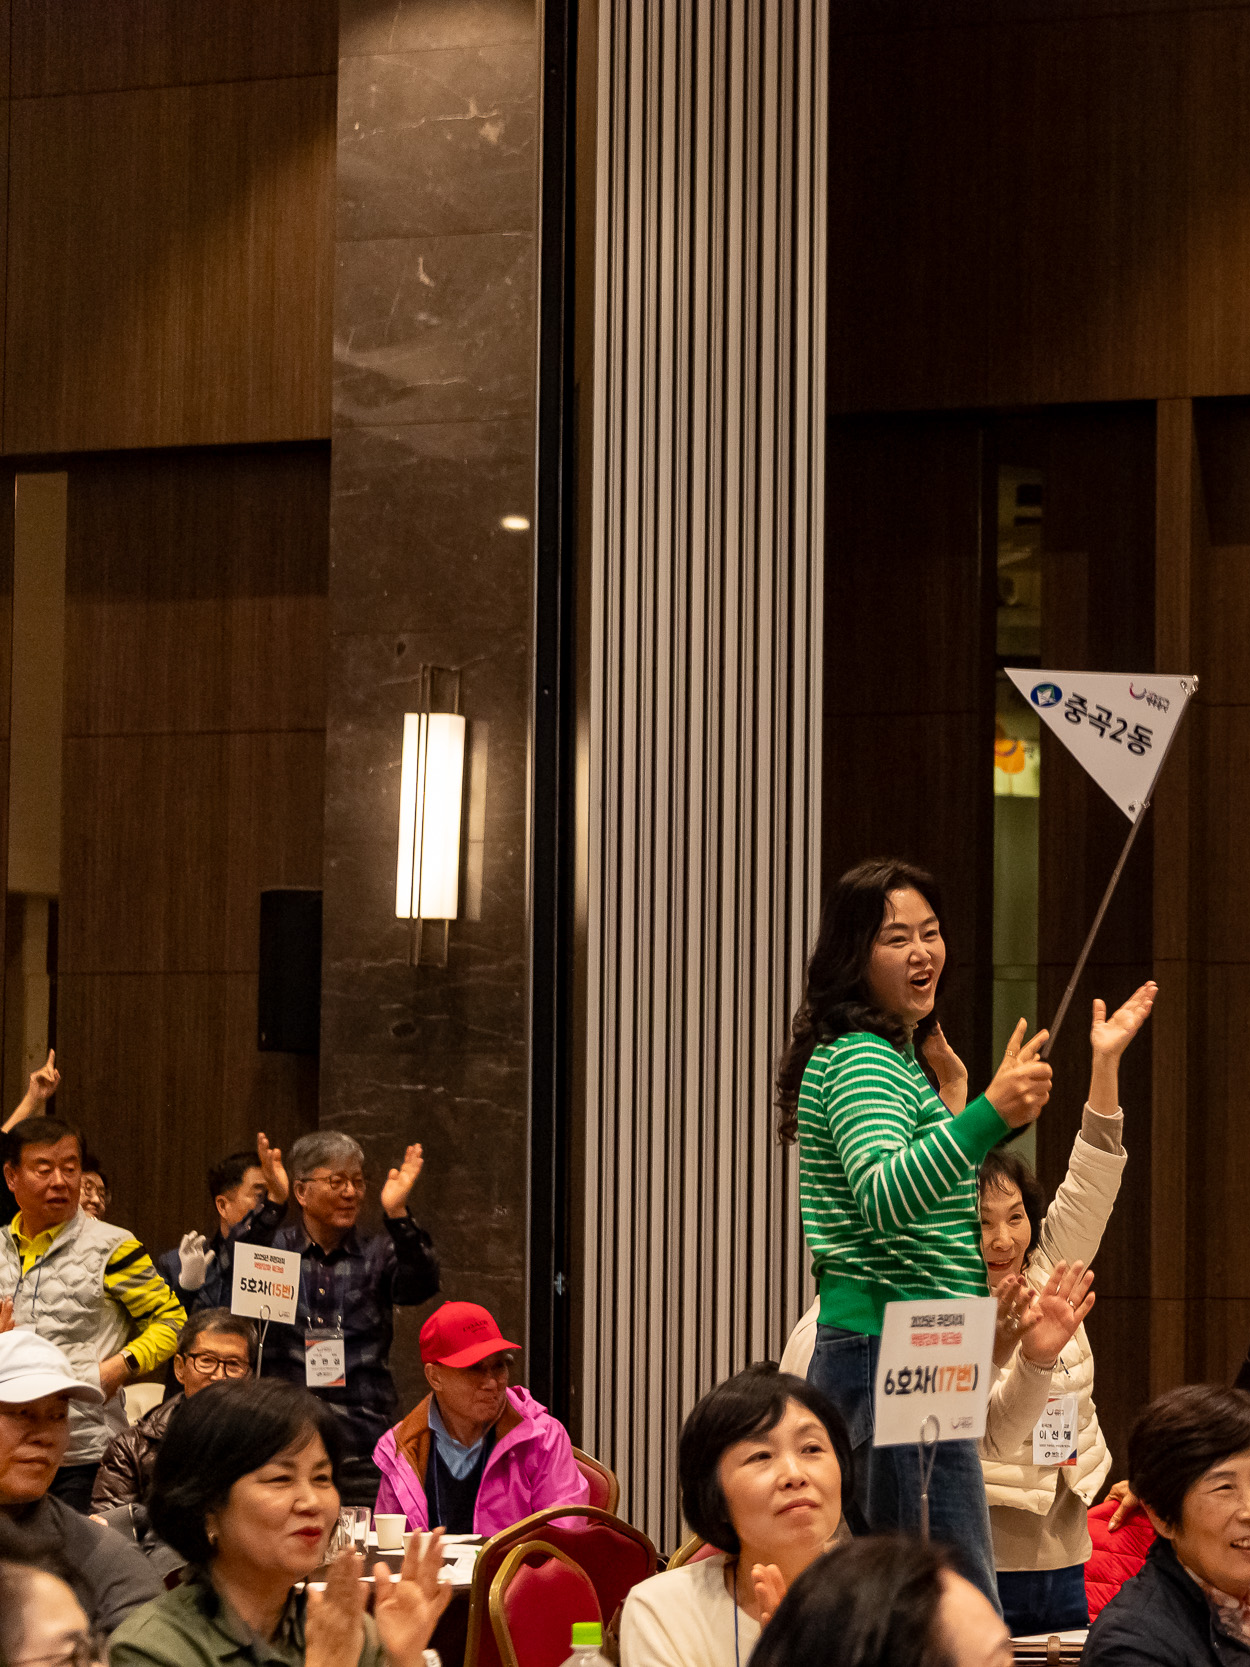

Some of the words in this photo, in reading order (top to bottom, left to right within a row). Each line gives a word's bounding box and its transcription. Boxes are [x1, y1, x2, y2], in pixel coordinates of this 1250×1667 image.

[1064, 692, 1154, 757] 중곡2동
[240, 1276, 295, 1301] 5호차(15번)
[884, 1362, 979, 1395] 6호차(17번)
